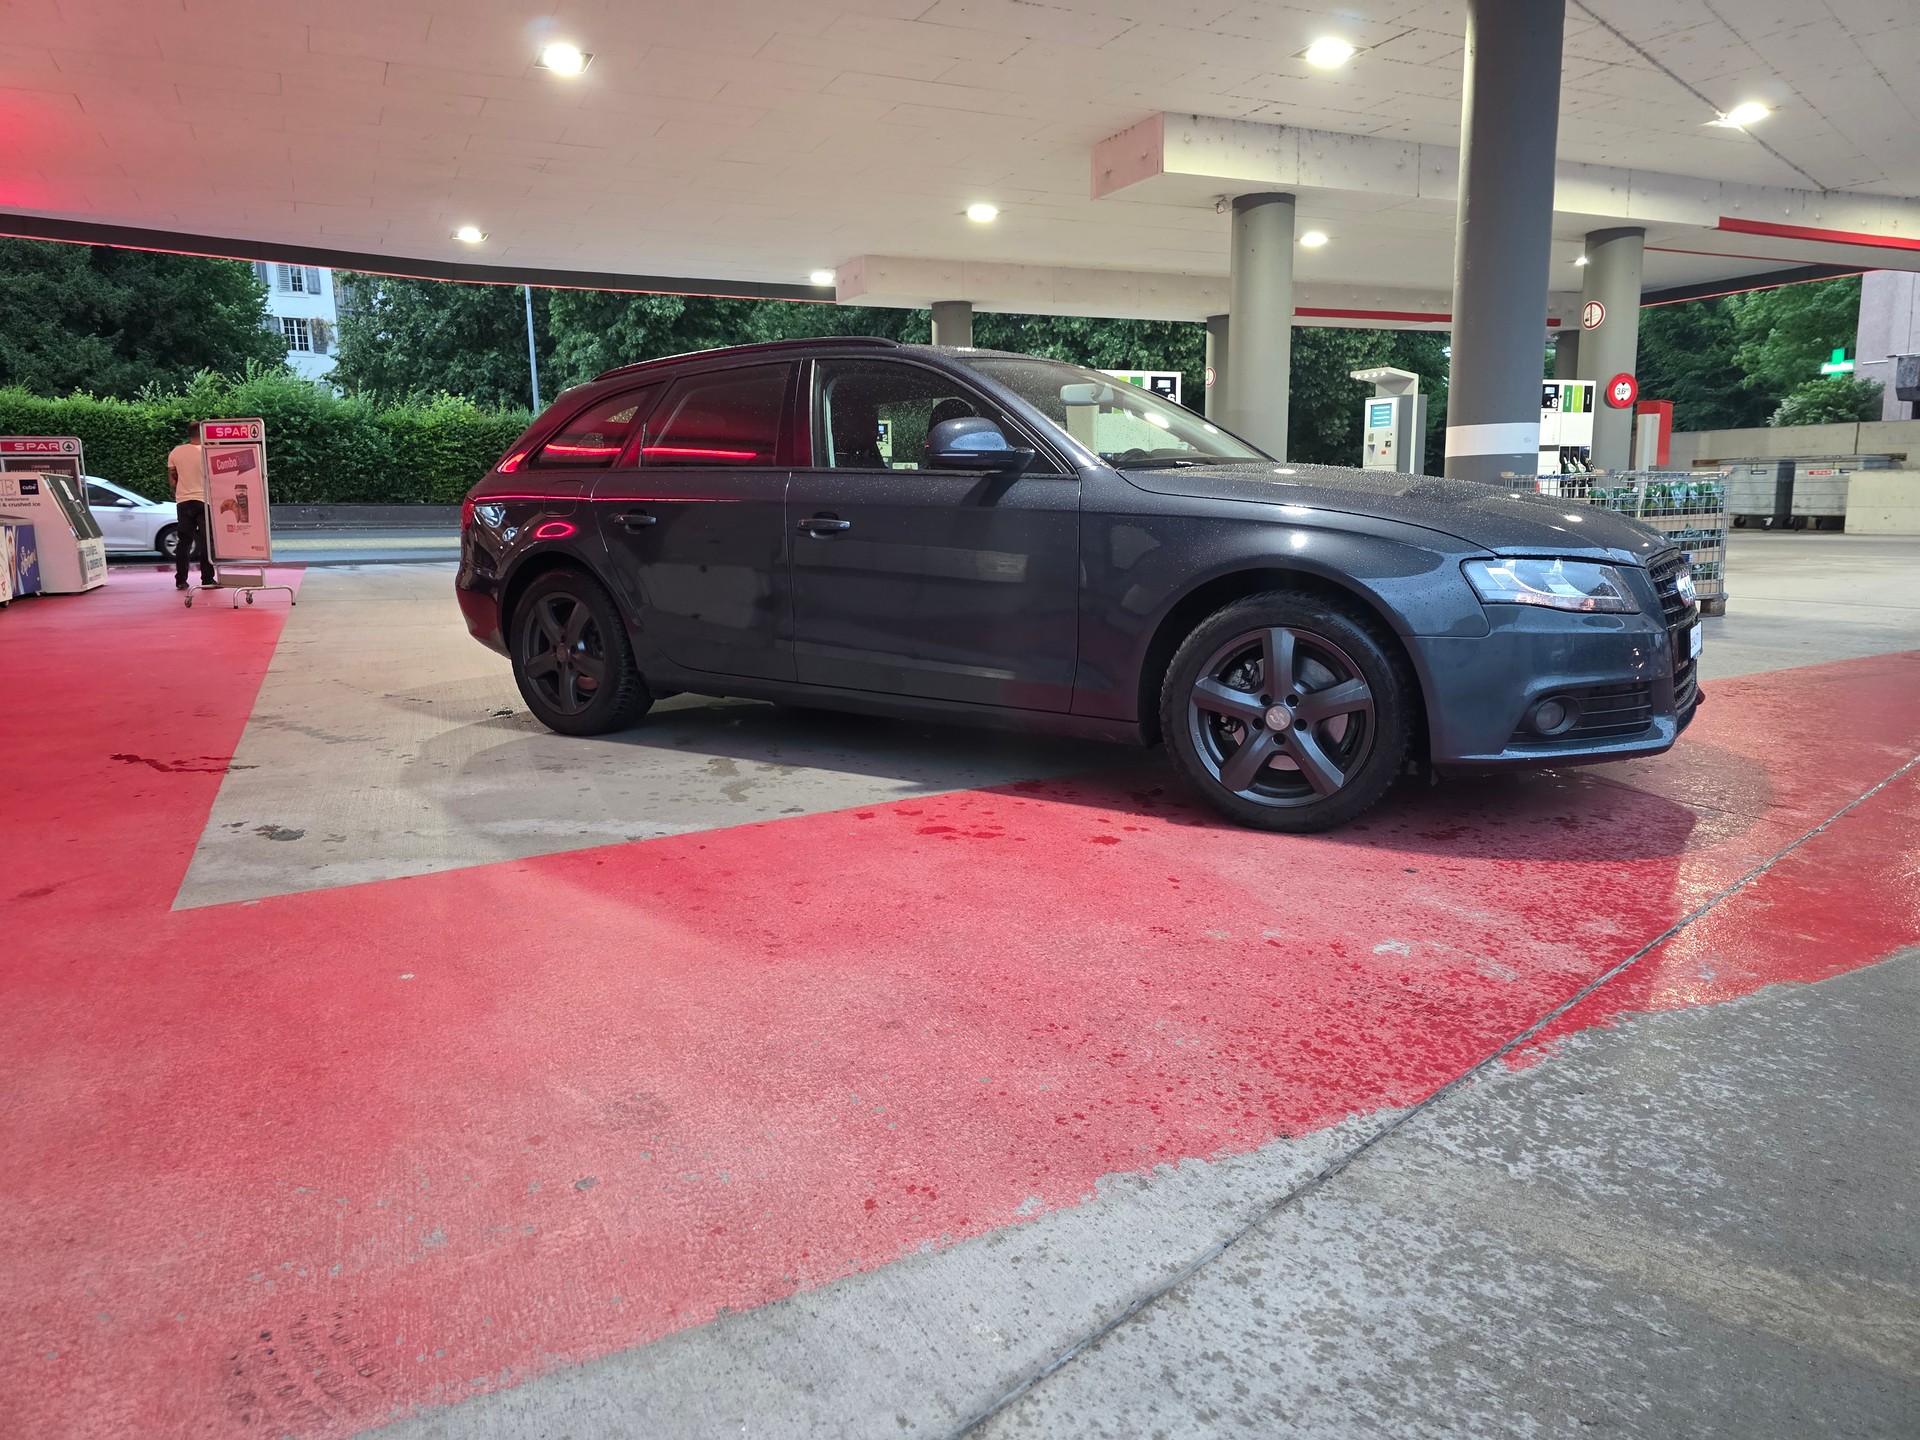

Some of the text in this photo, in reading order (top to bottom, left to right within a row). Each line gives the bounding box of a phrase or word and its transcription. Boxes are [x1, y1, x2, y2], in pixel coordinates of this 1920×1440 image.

[1551, 398, 1558, 408] 8
[216, 426, 248, 437] SPAR
[882, 434, 888, 442] 2
[216, 457, 238, 470] Combo
